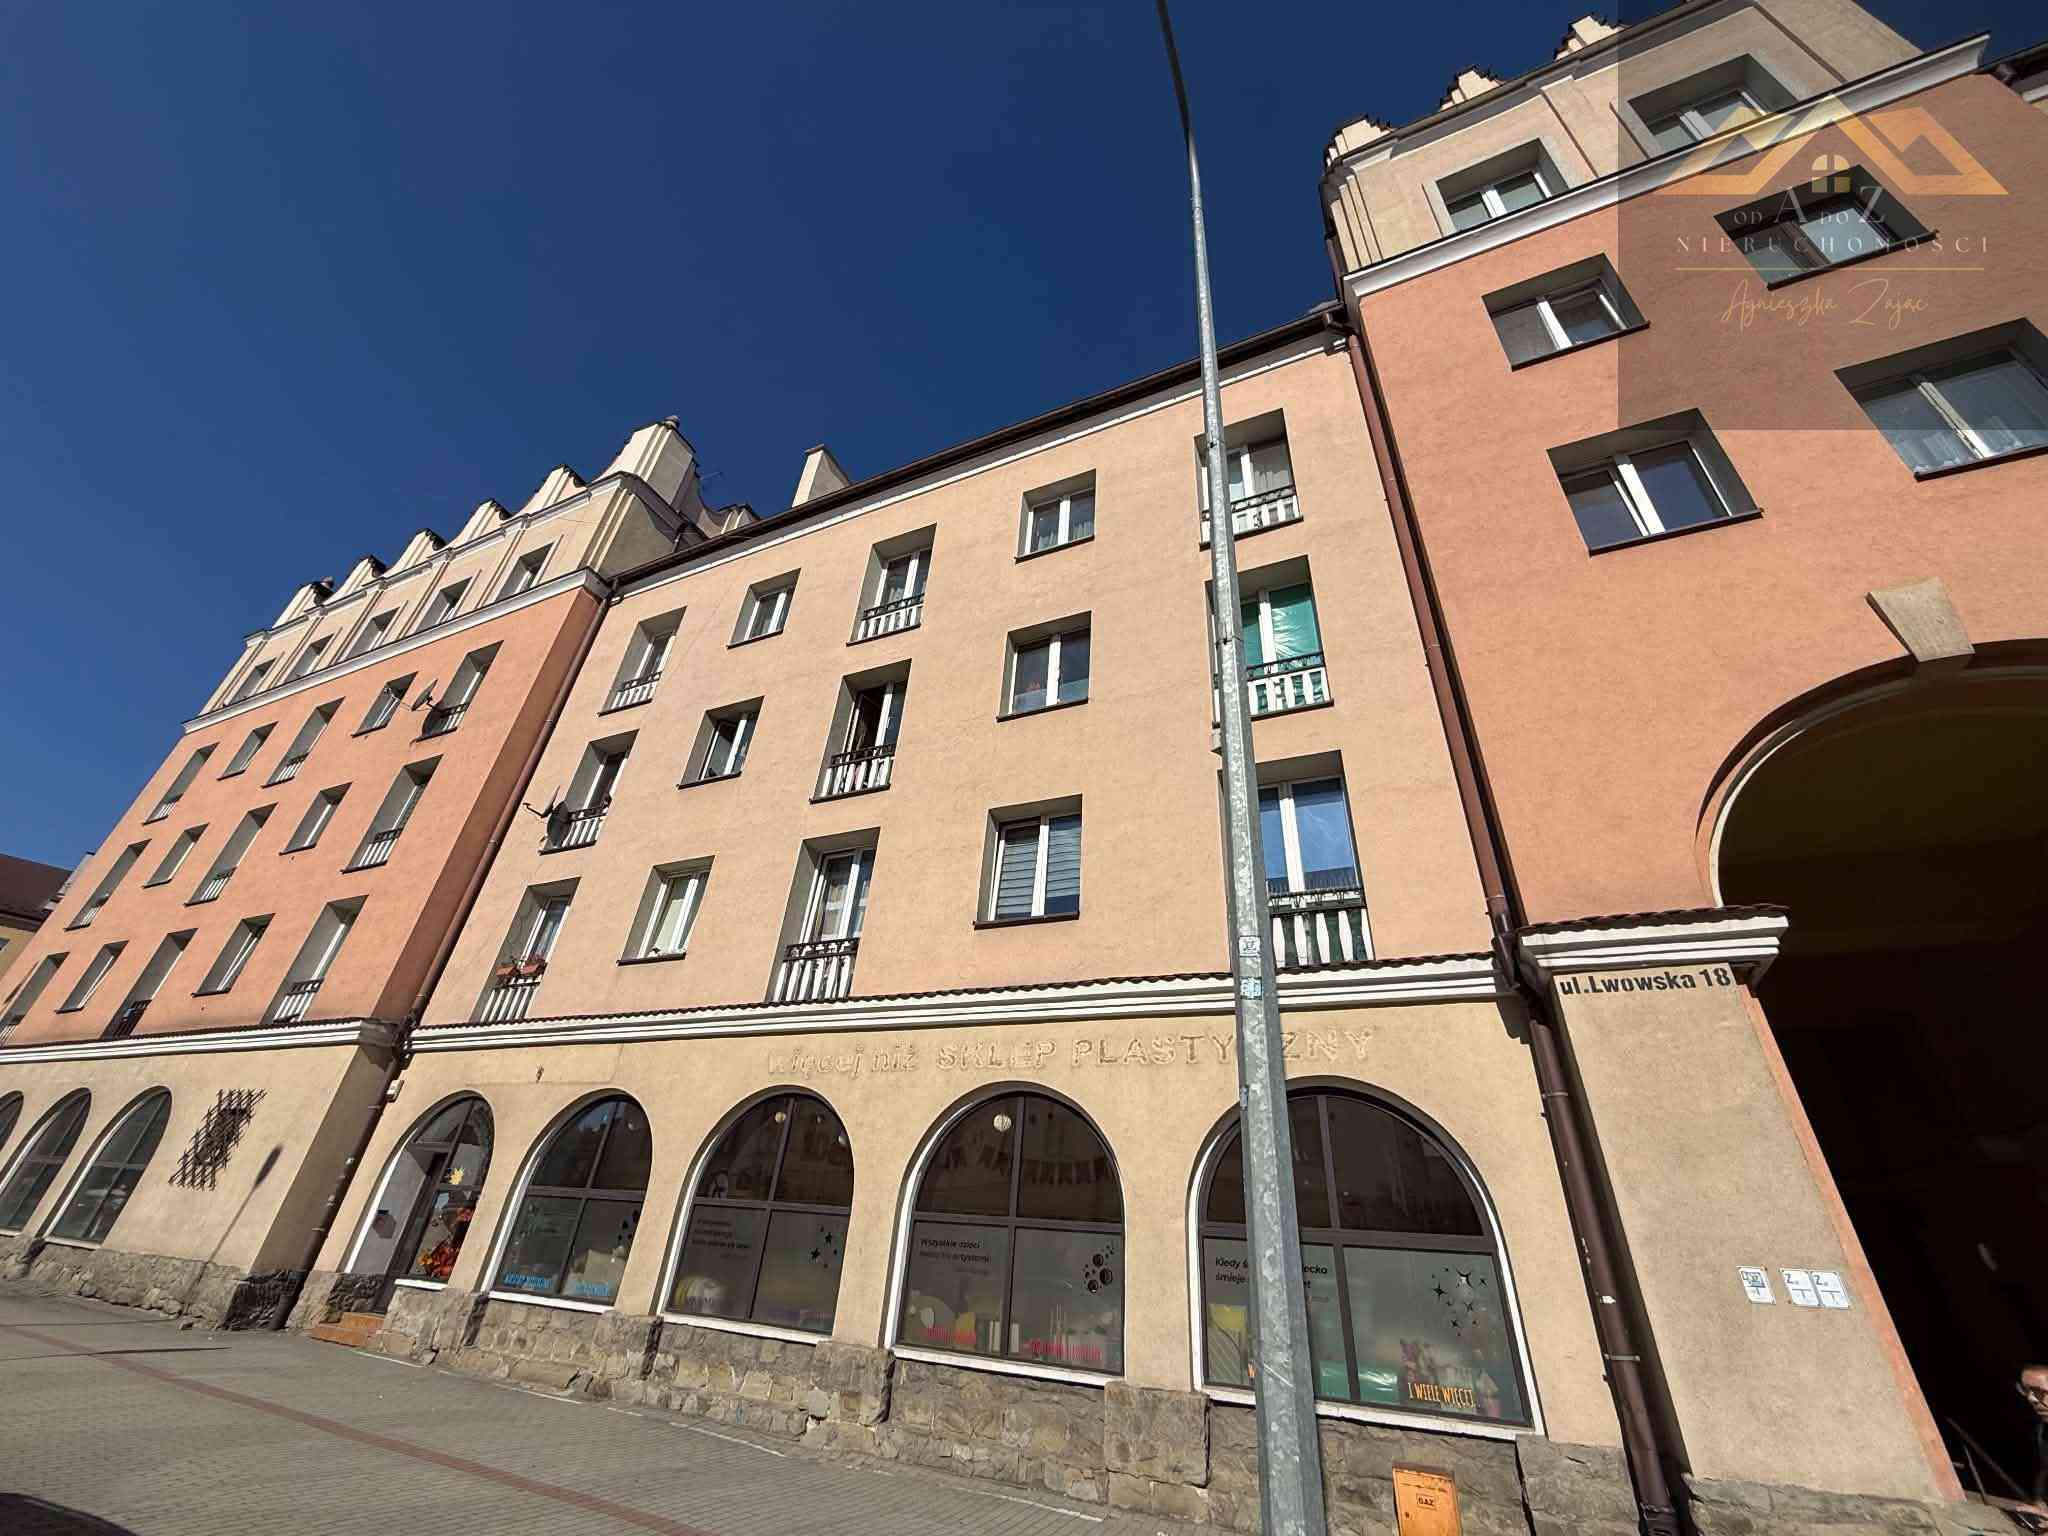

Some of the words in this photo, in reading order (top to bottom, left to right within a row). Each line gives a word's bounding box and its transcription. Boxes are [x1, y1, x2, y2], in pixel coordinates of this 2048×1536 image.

[1698, 967, 1732, 988] 18
[937, 1038, 1057, 1071] SKLEP
[1070, 1025, 1377, 1068] PLASTYZNY
